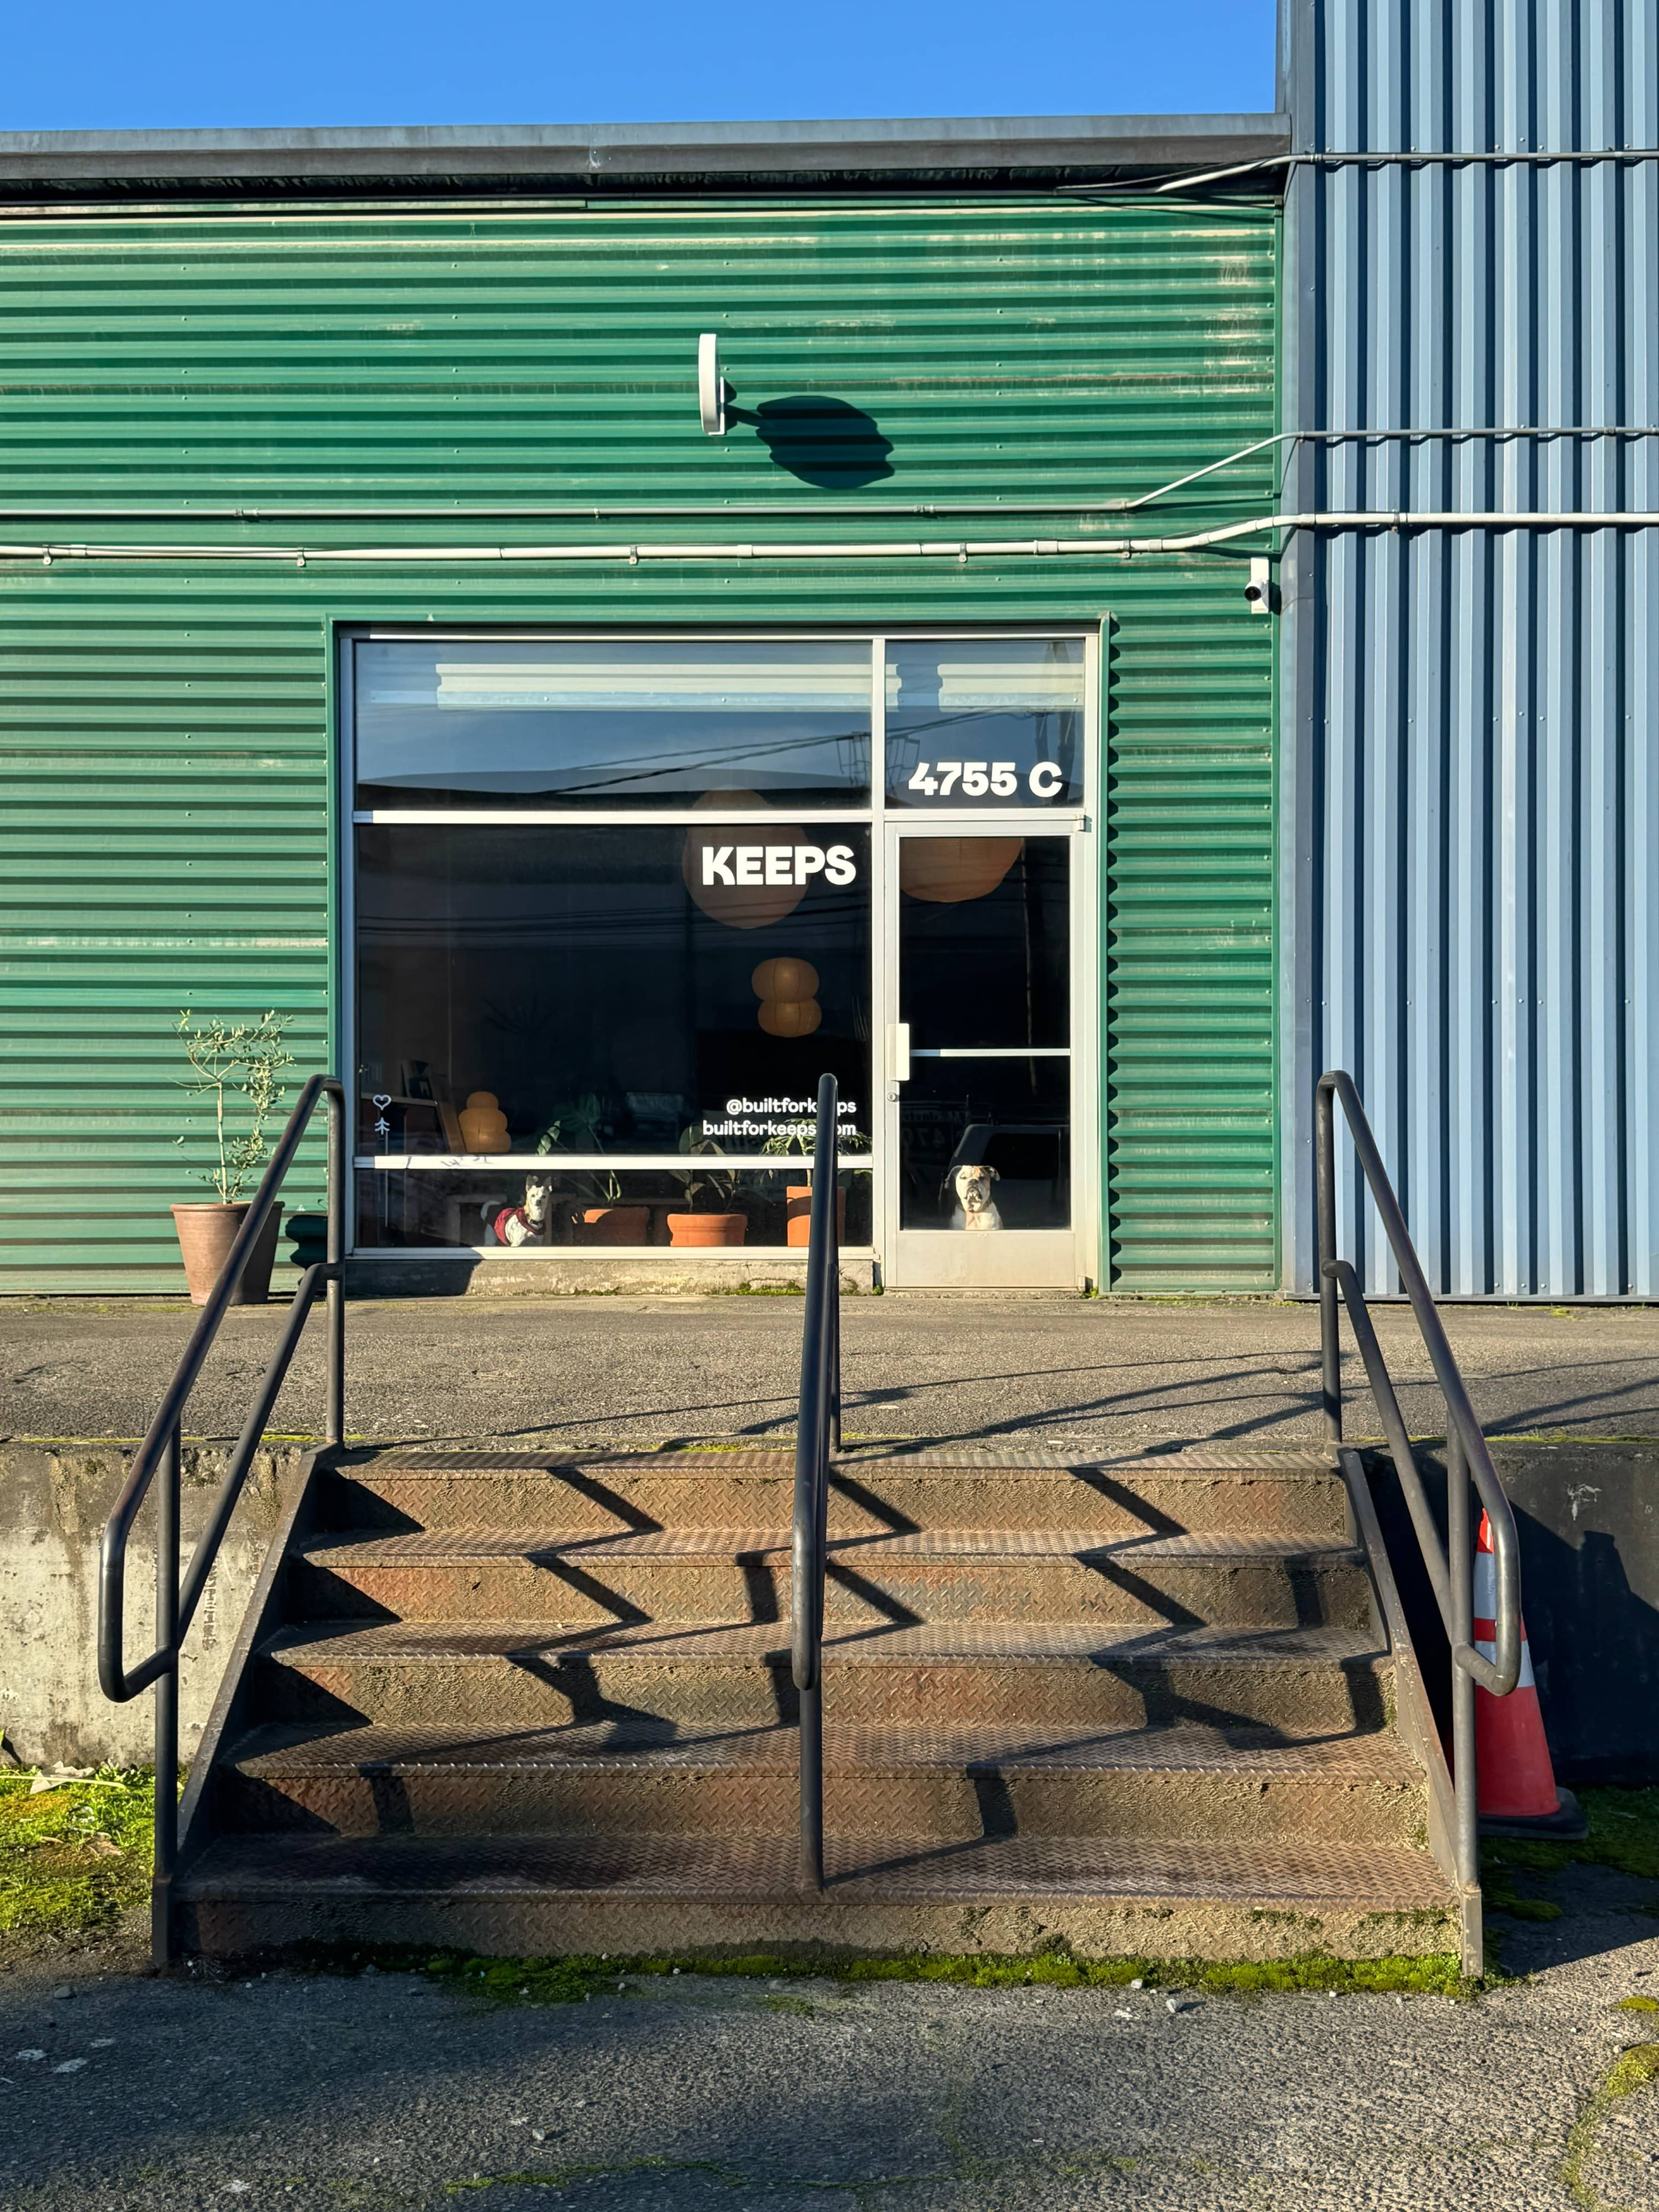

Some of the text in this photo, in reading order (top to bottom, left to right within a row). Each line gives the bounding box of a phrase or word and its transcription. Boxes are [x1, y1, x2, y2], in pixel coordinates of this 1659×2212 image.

[909, 761, 1062, 797] 4755 C
[702, 845, 856, 885] KEEPS
[726, 1097, 857, 1117] @builtforkps
[702, 1120, 857, 1139] builtforkeepsm
